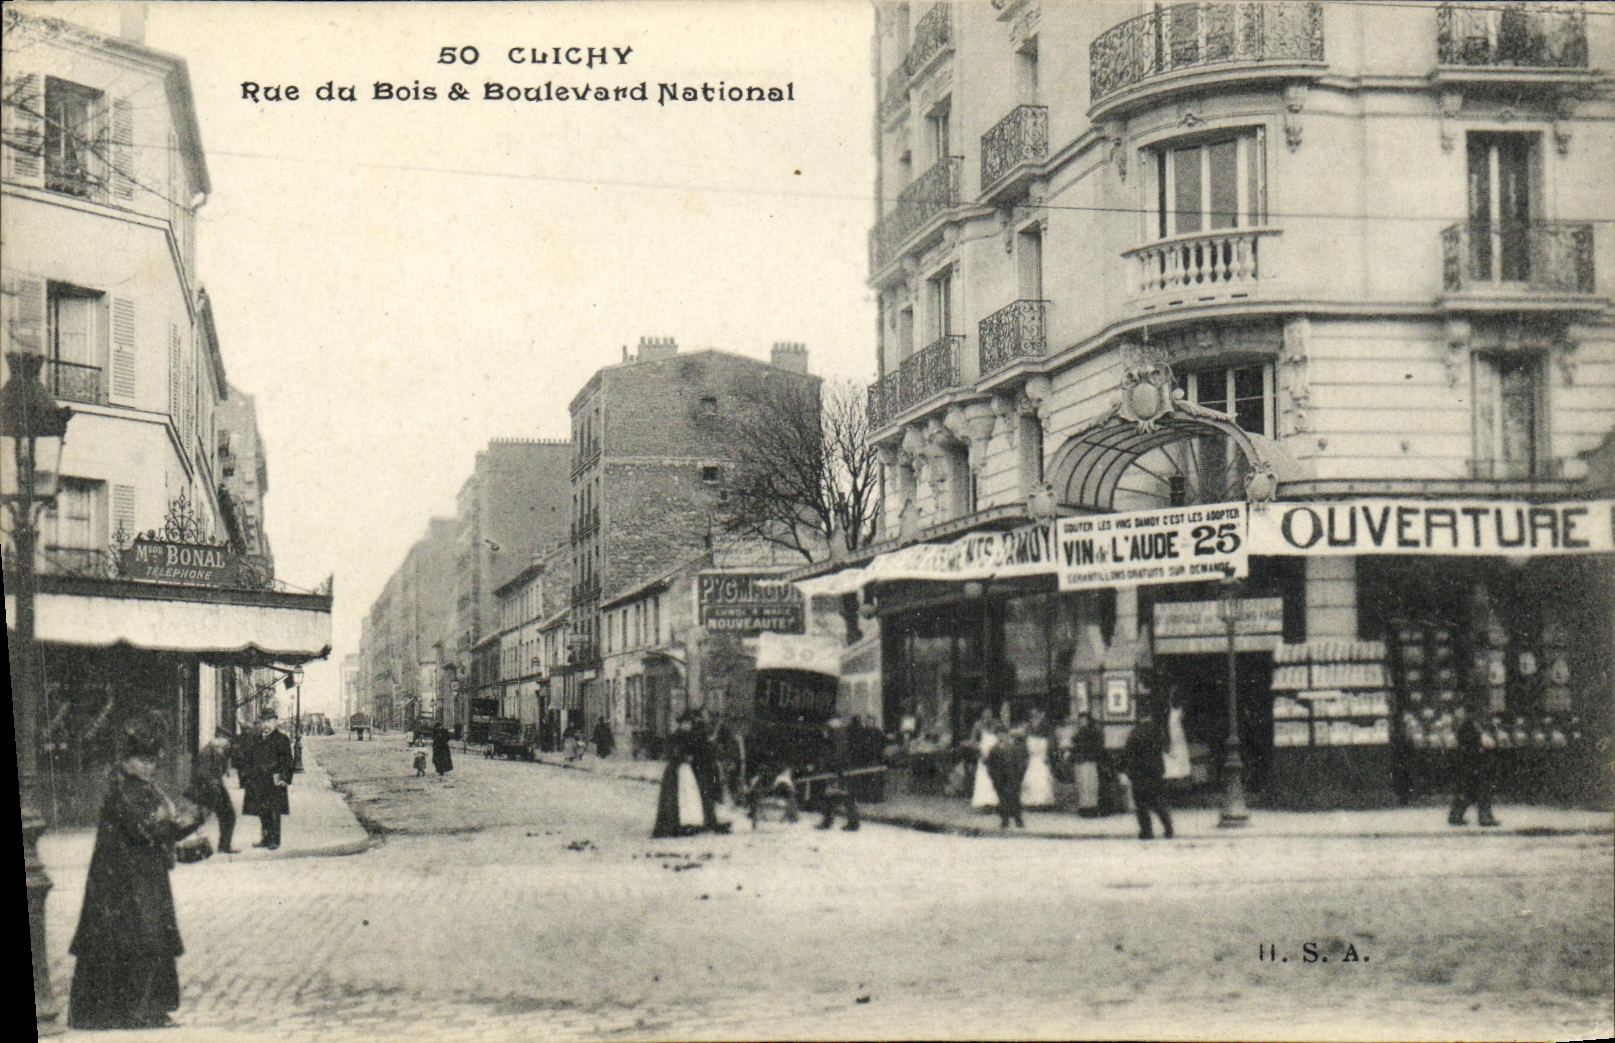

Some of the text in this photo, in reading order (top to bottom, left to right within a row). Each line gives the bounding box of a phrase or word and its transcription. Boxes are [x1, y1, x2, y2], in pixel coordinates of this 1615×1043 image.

[1098, 520, 1111, 531] LES
[1116, 518, 1131, 529] VINS
[1163, 513, 1184, 525] C'EST
[1188, 511, 1202, 522] LES
[1206, 508, 1239, 521] ADOPTER
[1281, 505, 1590, 549] OUVERTURE
[166, 545, 226, 569] BONAL
[1063, 538, 1094, 566] VIN
[1111, 531, 1180, 563] L'AUDE
[1191, 523, 1241, 556] 25
